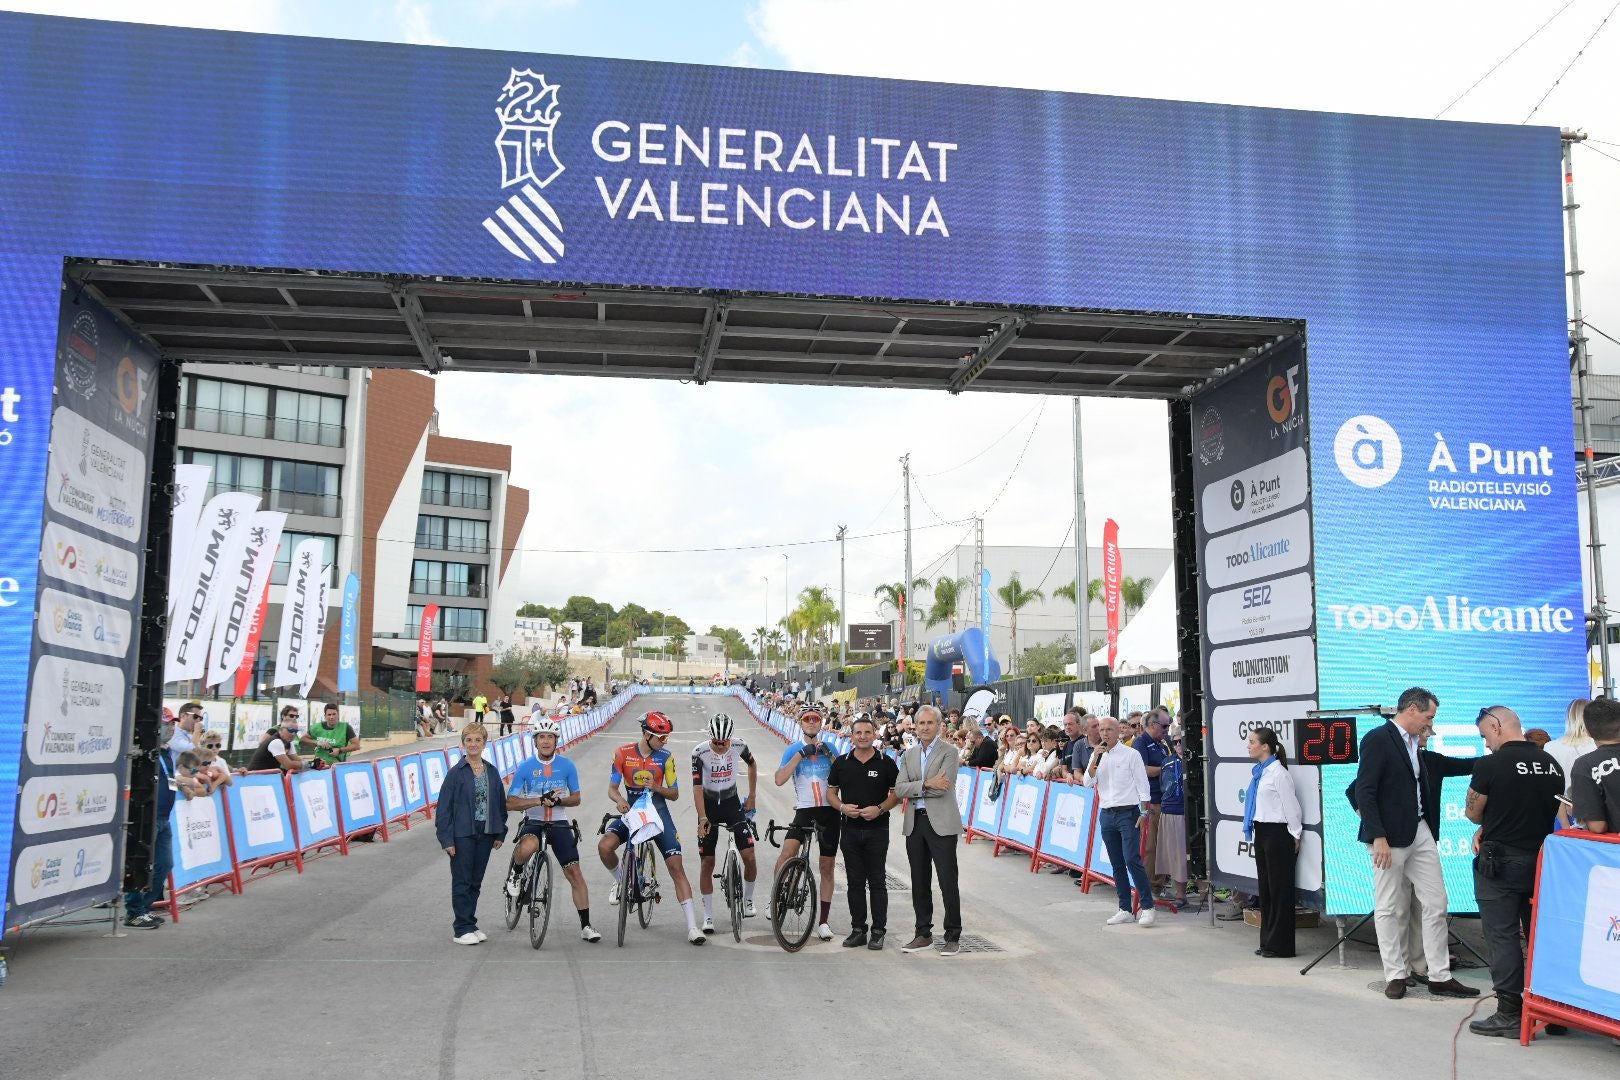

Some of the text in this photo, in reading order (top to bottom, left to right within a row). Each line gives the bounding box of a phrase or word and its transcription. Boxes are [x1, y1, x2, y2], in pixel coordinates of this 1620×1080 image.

[592, 120, 958, 183] GENERALITAT
[594, 176, 950, 238] VALENCIANA
[1270, 413, 1304, 440] LA NUCIA
[1428, 432, 1554, 476] À Punt
[1260, 475, 1280, 495] Punt
[1429, 478, 1551, 496] RADIOTELEVISIÓ
[1429, 497, 1527, 511] VALENCIANA
[176, 528, 226, 666] PODIUM
[220, 546, 259, 670] PODIUM
[1327, 595, 1574, 633] TODOAlicante
[287, 568, 308, 674] PODIUM
[422, 616, 432, 657] CRITERIUM
[1303, 721, 1351, 761] 20
[711, 763, 732, 773] UAE
[1517, 762, 1562, 777] S.E.A.
